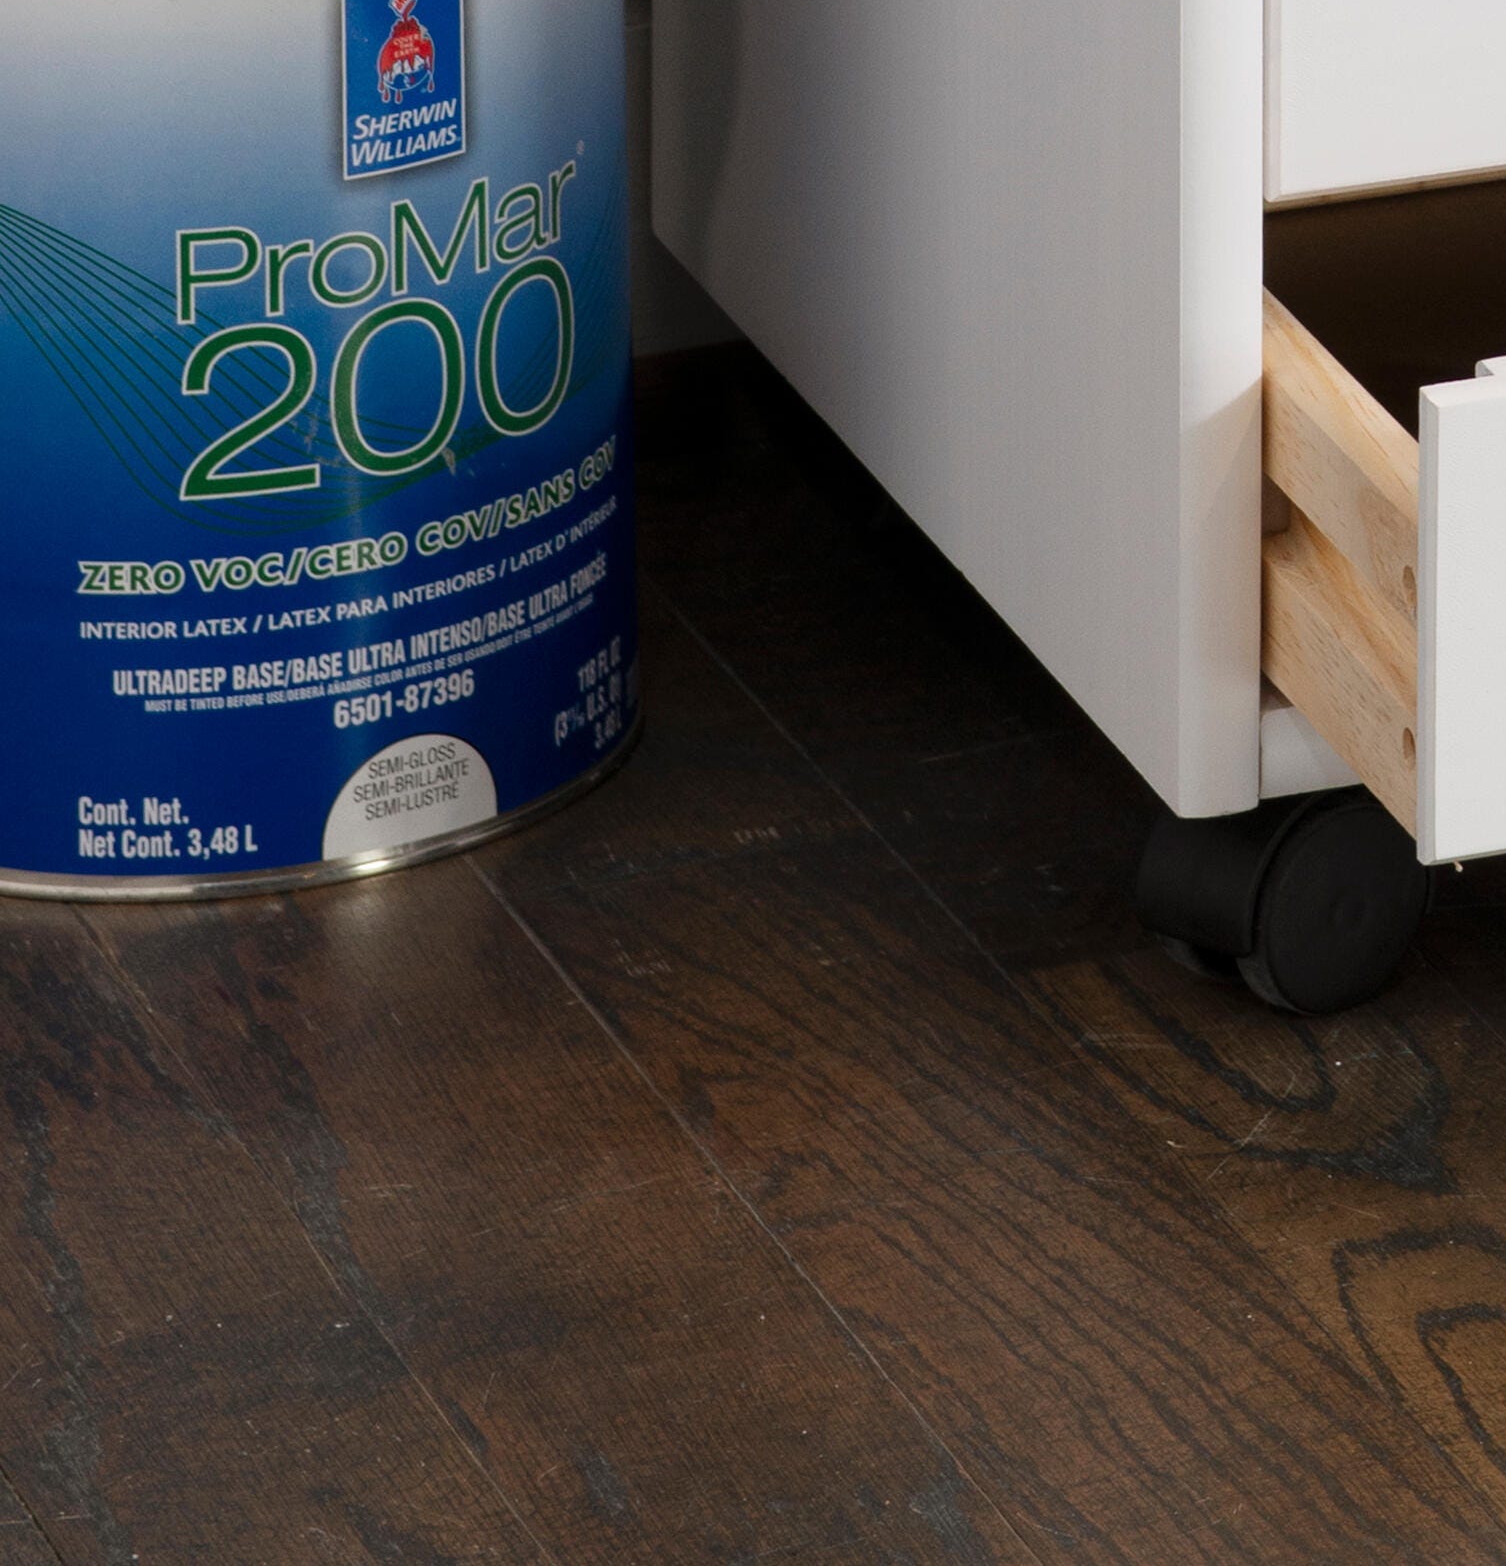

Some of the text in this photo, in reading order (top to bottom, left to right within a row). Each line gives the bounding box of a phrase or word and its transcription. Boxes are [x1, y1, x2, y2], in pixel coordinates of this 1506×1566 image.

[352, 98, 457, 140] SHERWIN
[351, 125, 458, 167] WILLIAMS
[175, 160, 576, 325] ProMar
[180, 255, 575, 501] 200
[77, 560, 185, 595] ZERO
[80, 621, 177, 639] INTERIOR
[183, 617, 246, 638] LATEX
[268, 606, 331, 631] LATEX
[336, 596, 388, 621] PARA
[392, 564, 496, 609] INTERIORES
[510, 541, 553, 572] LATEX
[113, 667, 226, 696] ULTRADEEP
[232, 652, 342, 691] BASE/BASE
[349, 639, 406, 674] ULTRA
[411, 599, 525, 660] INTENSO/BASE
[529, 580, 568, 620] ULTRA
[334, 668, 475, 729] 6501-87396
[353, 758, 470, 804] SEMI-BRILLANTE
[367, 741, 457, 780] SEMI-GLOSS
[78, 795, 189, 826] Cont. Net.
[365, 782, 460, 822] SEMI-LUSTRÉ
[78, 825, 258, 860] Net Cont. 3,48 L
